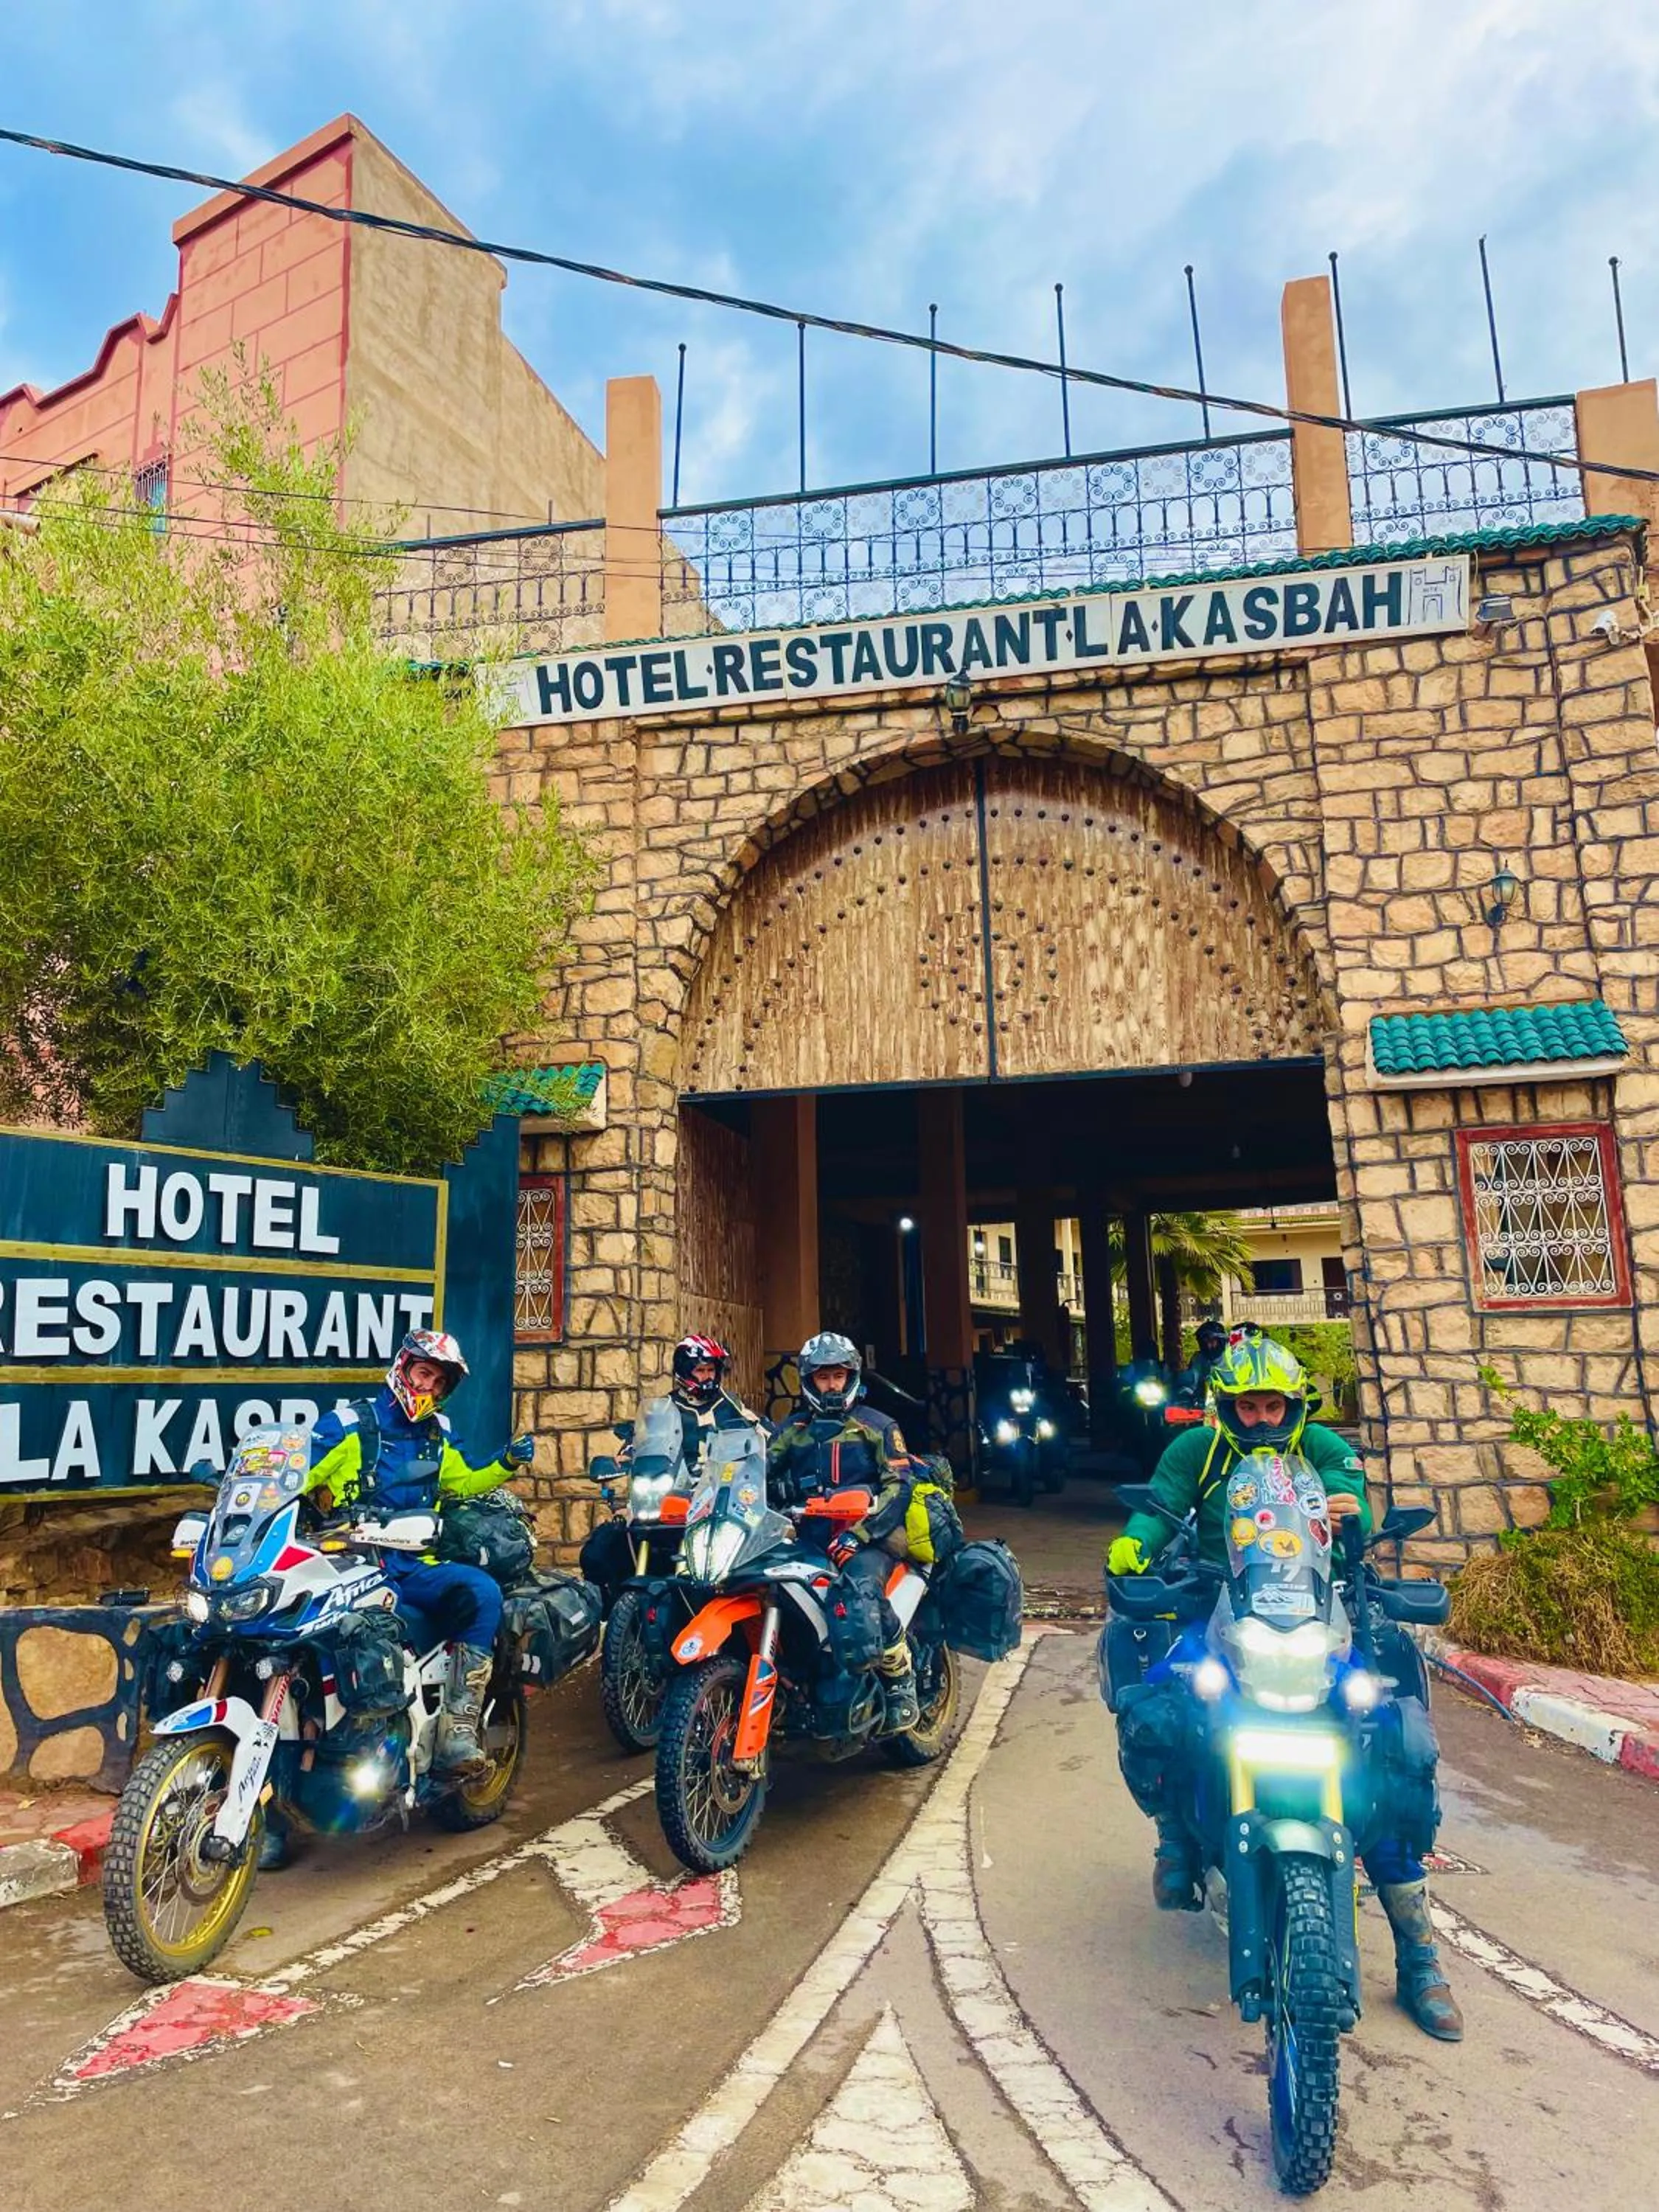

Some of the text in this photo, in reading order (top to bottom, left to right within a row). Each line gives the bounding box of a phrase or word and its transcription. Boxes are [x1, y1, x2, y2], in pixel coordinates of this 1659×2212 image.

[536, 572, 1402, 715] HOTEL RESTAURANT LA KASBAH
[106, 1163, 339, 1253] HOTEL
[0, 1278, 434, 1358] ESTAURANT
[0, 1401, 100, 1482] LA
